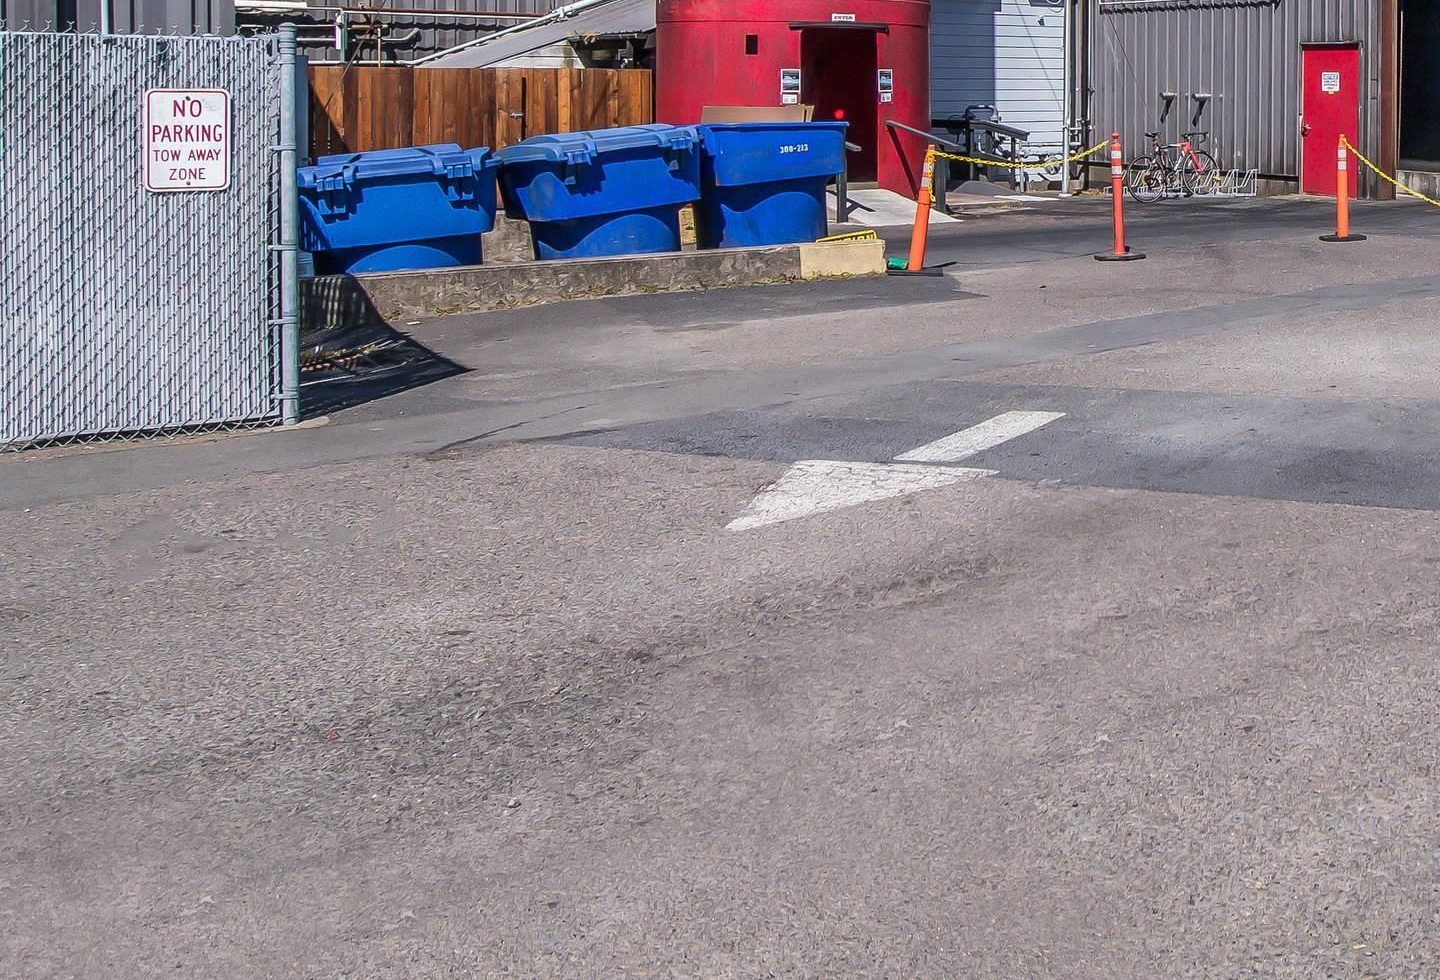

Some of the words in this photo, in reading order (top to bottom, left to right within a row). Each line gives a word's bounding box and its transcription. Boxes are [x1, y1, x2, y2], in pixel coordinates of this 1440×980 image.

[173, 99, 202, 117] NO
[152, 124, 223, 142] PARKING
[153, 149, 181, 162] TOW
[188, 149, 221, 161] AWAY
[169, 168, 206, 180] ZONE
